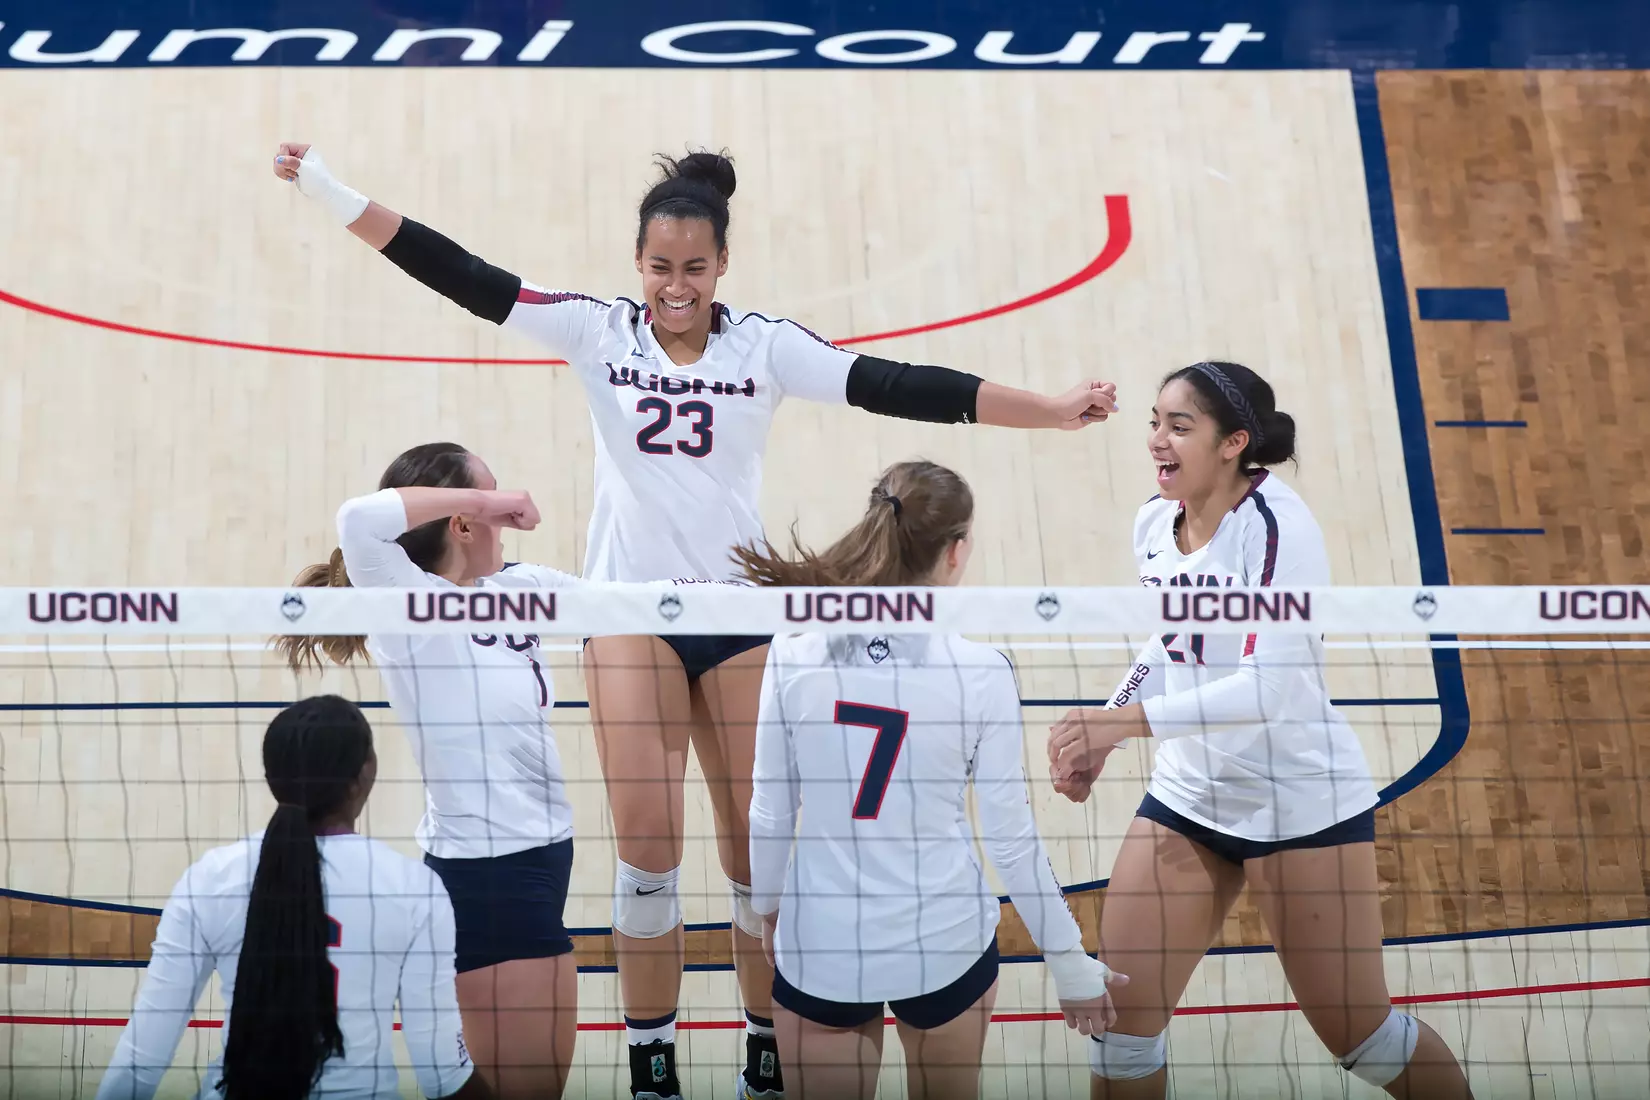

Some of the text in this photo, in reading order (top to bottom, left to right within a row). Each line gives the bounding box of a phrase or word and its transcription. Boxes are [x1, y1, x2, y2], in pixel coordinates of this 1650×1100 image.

[0, 21, 1265, 64] umni Court
[636, 396, 714, 458] 23
[29, 590, 1650, 622] UCONN UCONN UCONN UCONN UCON
[834, 700, 909, 820] 7
